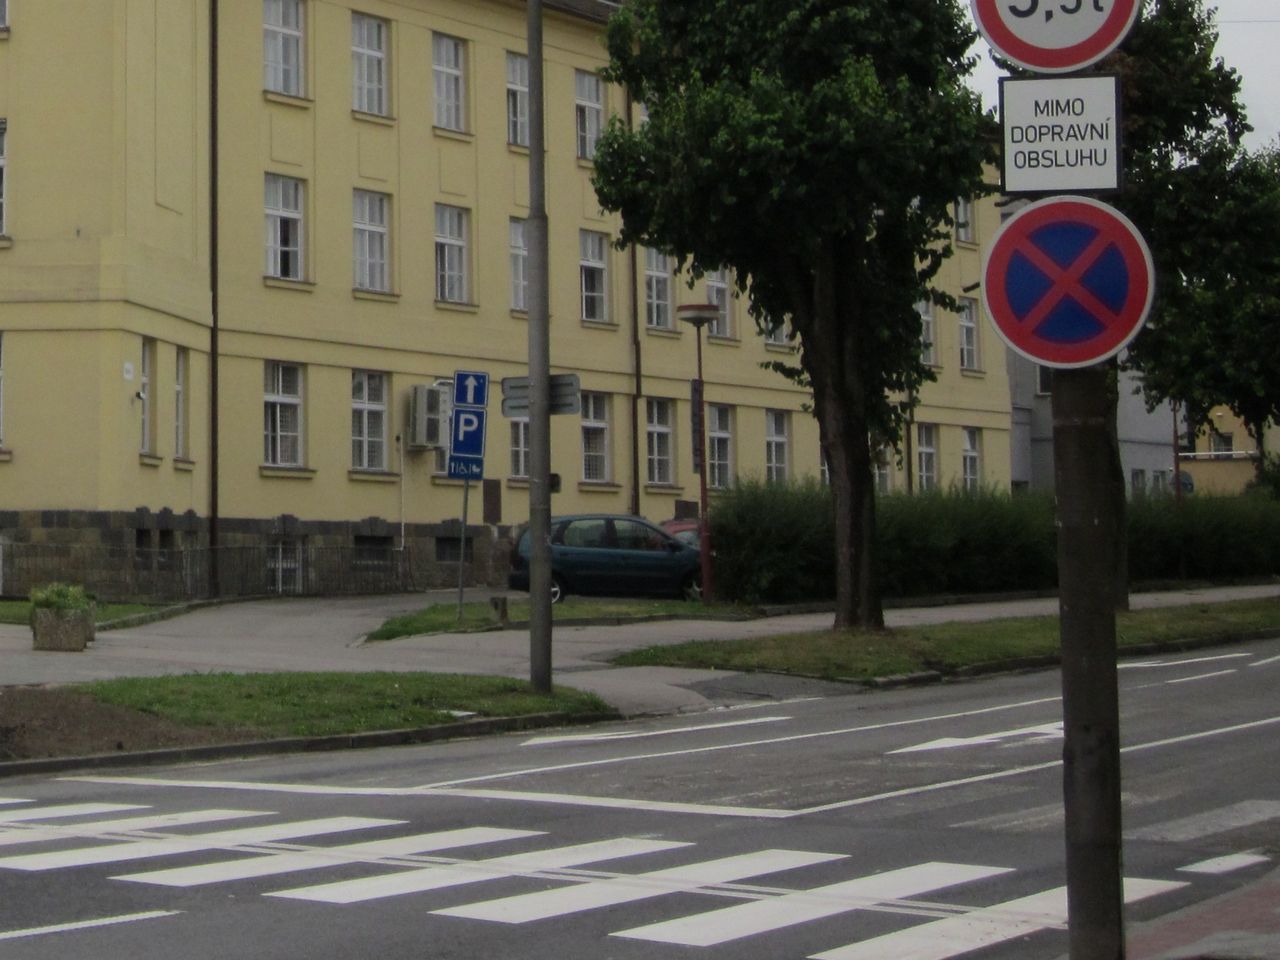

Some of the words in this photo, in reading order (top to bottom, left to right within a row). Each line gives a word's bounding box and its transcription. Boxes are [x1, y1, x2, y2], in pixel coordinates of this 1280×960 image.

[1034, 97, 1085, 118] MIMO
[1010, 117, 1111, 144] DOPRAVNÍ
[1013, 148, 1108, 169] OBSLUHU
[458, 413, 479, 442] P
